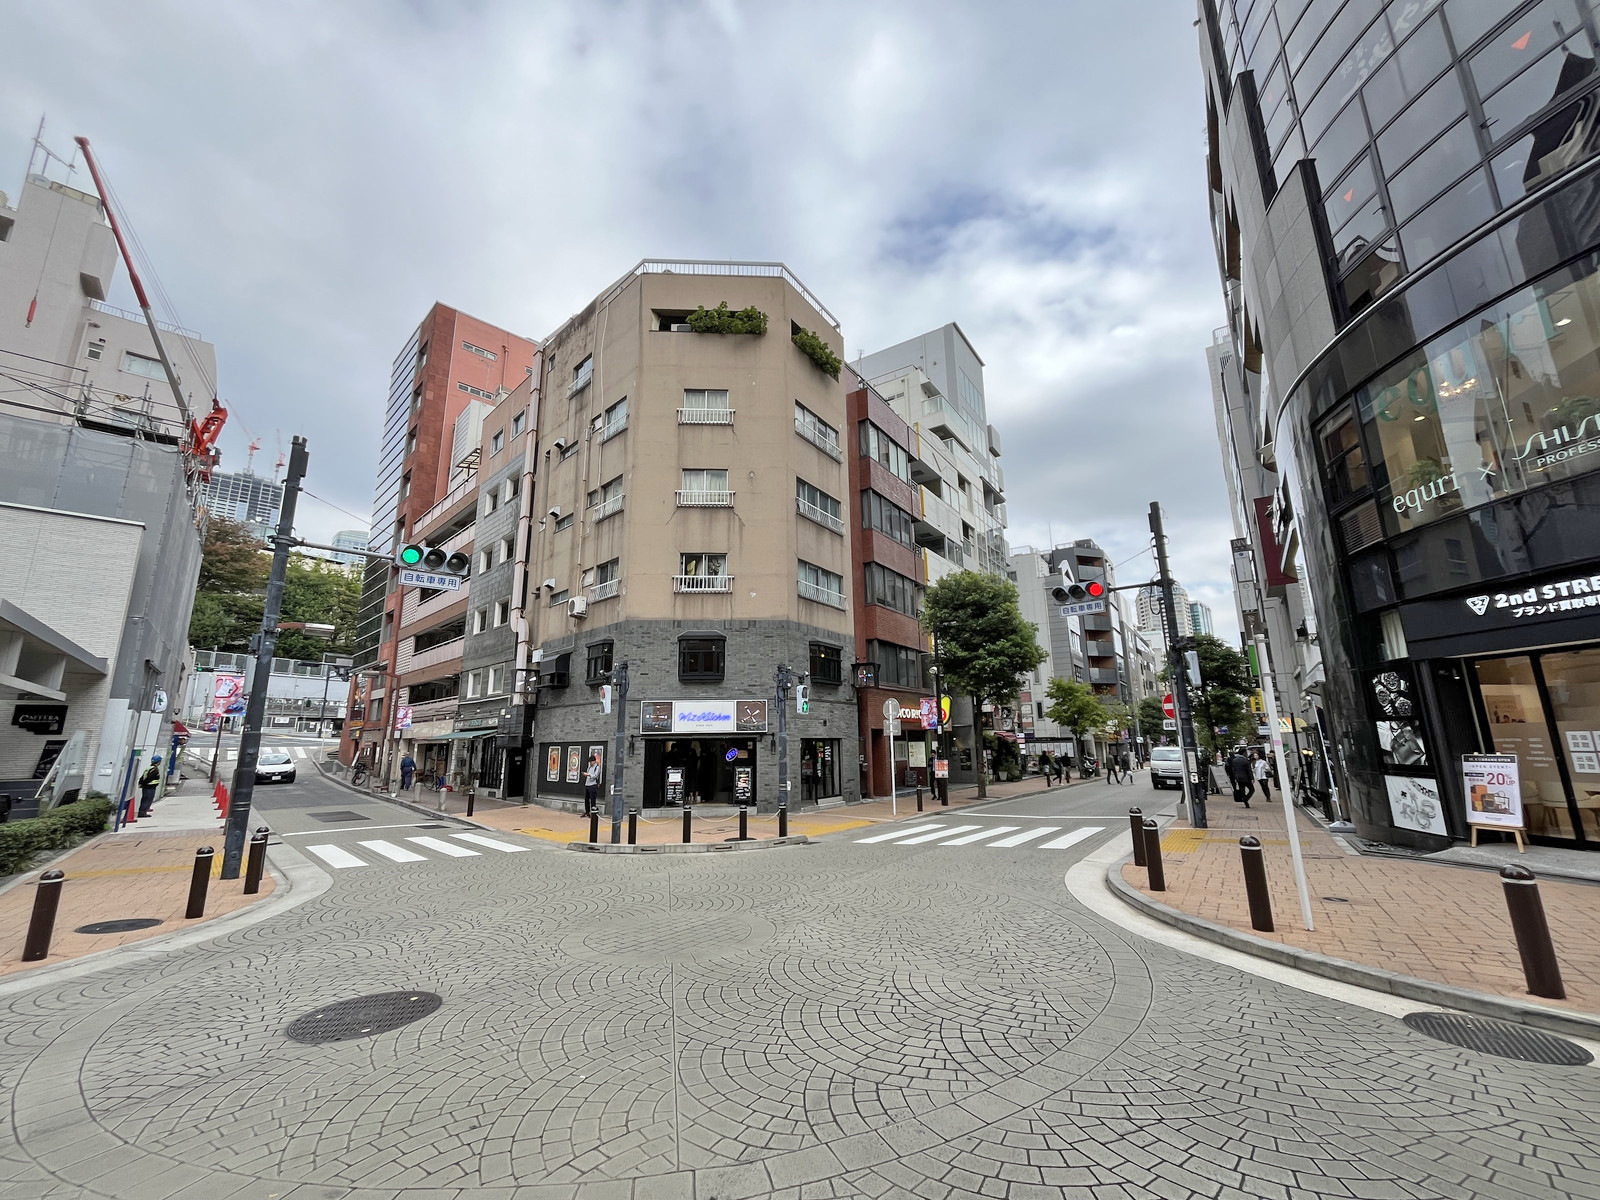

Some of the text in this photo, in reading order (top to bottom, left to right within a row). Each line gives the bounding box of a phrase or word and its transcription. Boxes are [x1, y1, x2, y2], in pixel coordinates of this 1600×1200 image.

[1392, 466, 1461, 513] equri
[1512, 413, 1600, 460] SHIS
[404, 572, 457, 588] 自転車専用
[1062, 602, 1102, 615] 自転車専用
[1494, 587, 1538, 609] 2nd
[1512, 595, 1600, 618] ブランド買取専
